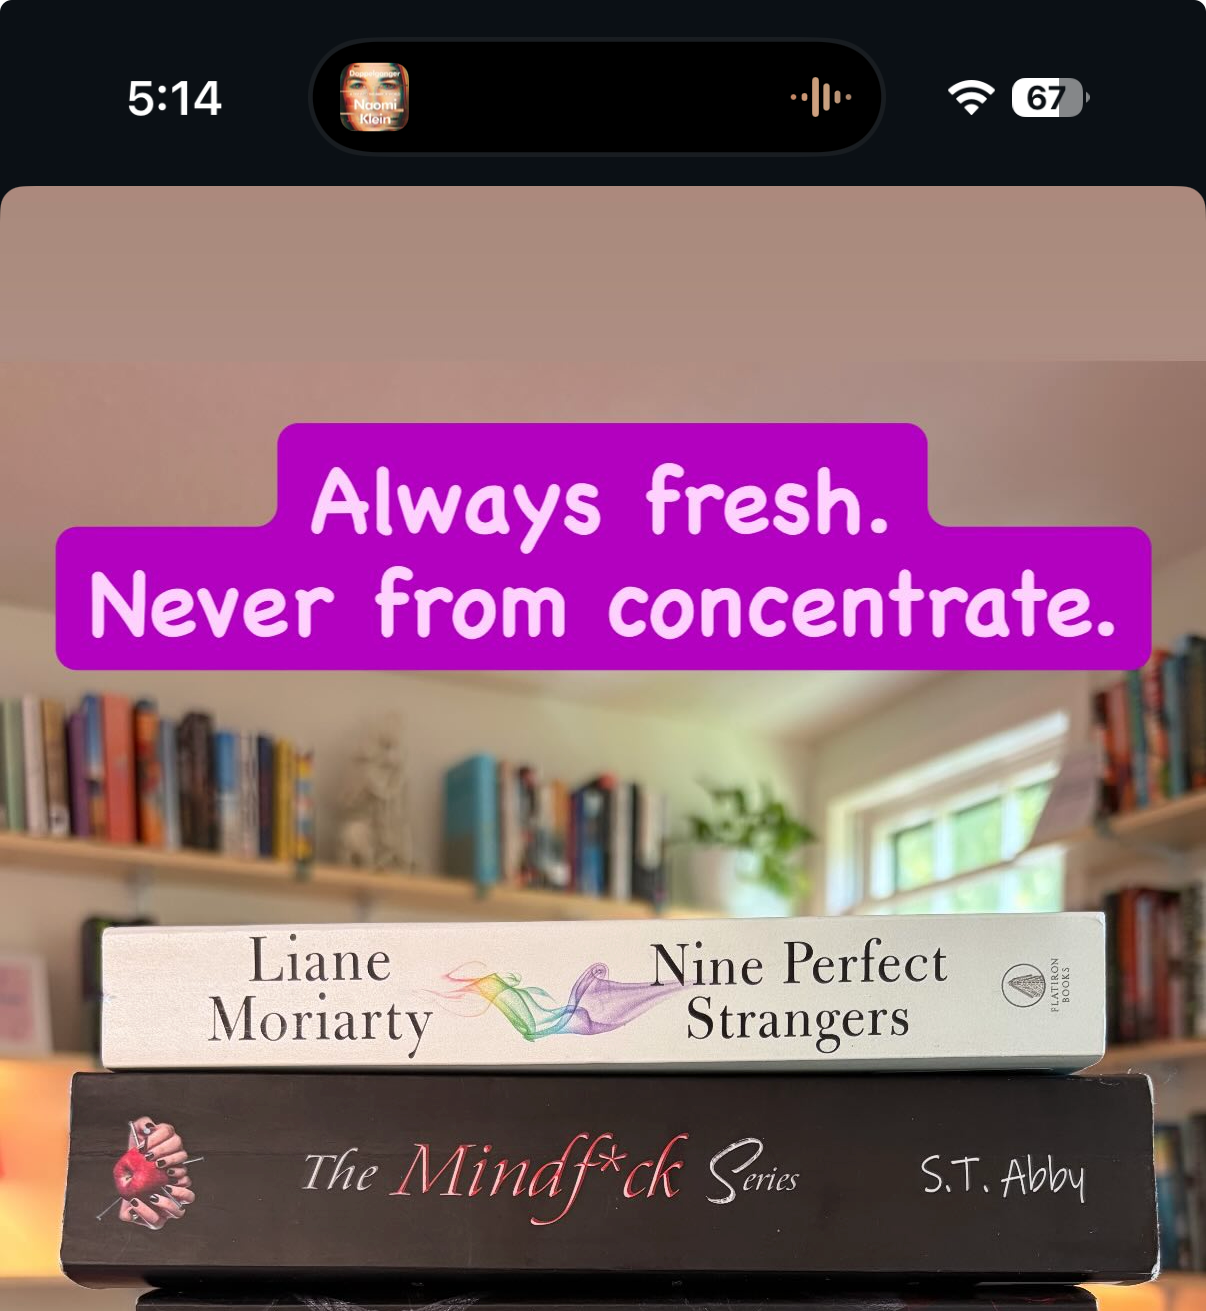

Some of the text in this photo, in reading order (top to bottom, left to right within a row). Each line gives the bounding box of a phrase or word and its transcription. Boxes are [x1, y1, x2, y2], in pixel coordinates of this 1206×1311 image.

[248, 933, 391, 982] Liane
[650, 937, 948, 987] Nine Perfect
[1050, 957, 1059, 1012] FLATIRON
[1061, 967, 1070, 1003] BOOKS
[207, 991, 433, 1058] Moriarty
[687, 995, 910, 1054] Strangers
[301, 1147, 379, 1192] The
[706, 1137, 799, 1204] Series
[920, 1153, 1086, 1203] S.T. Abby
